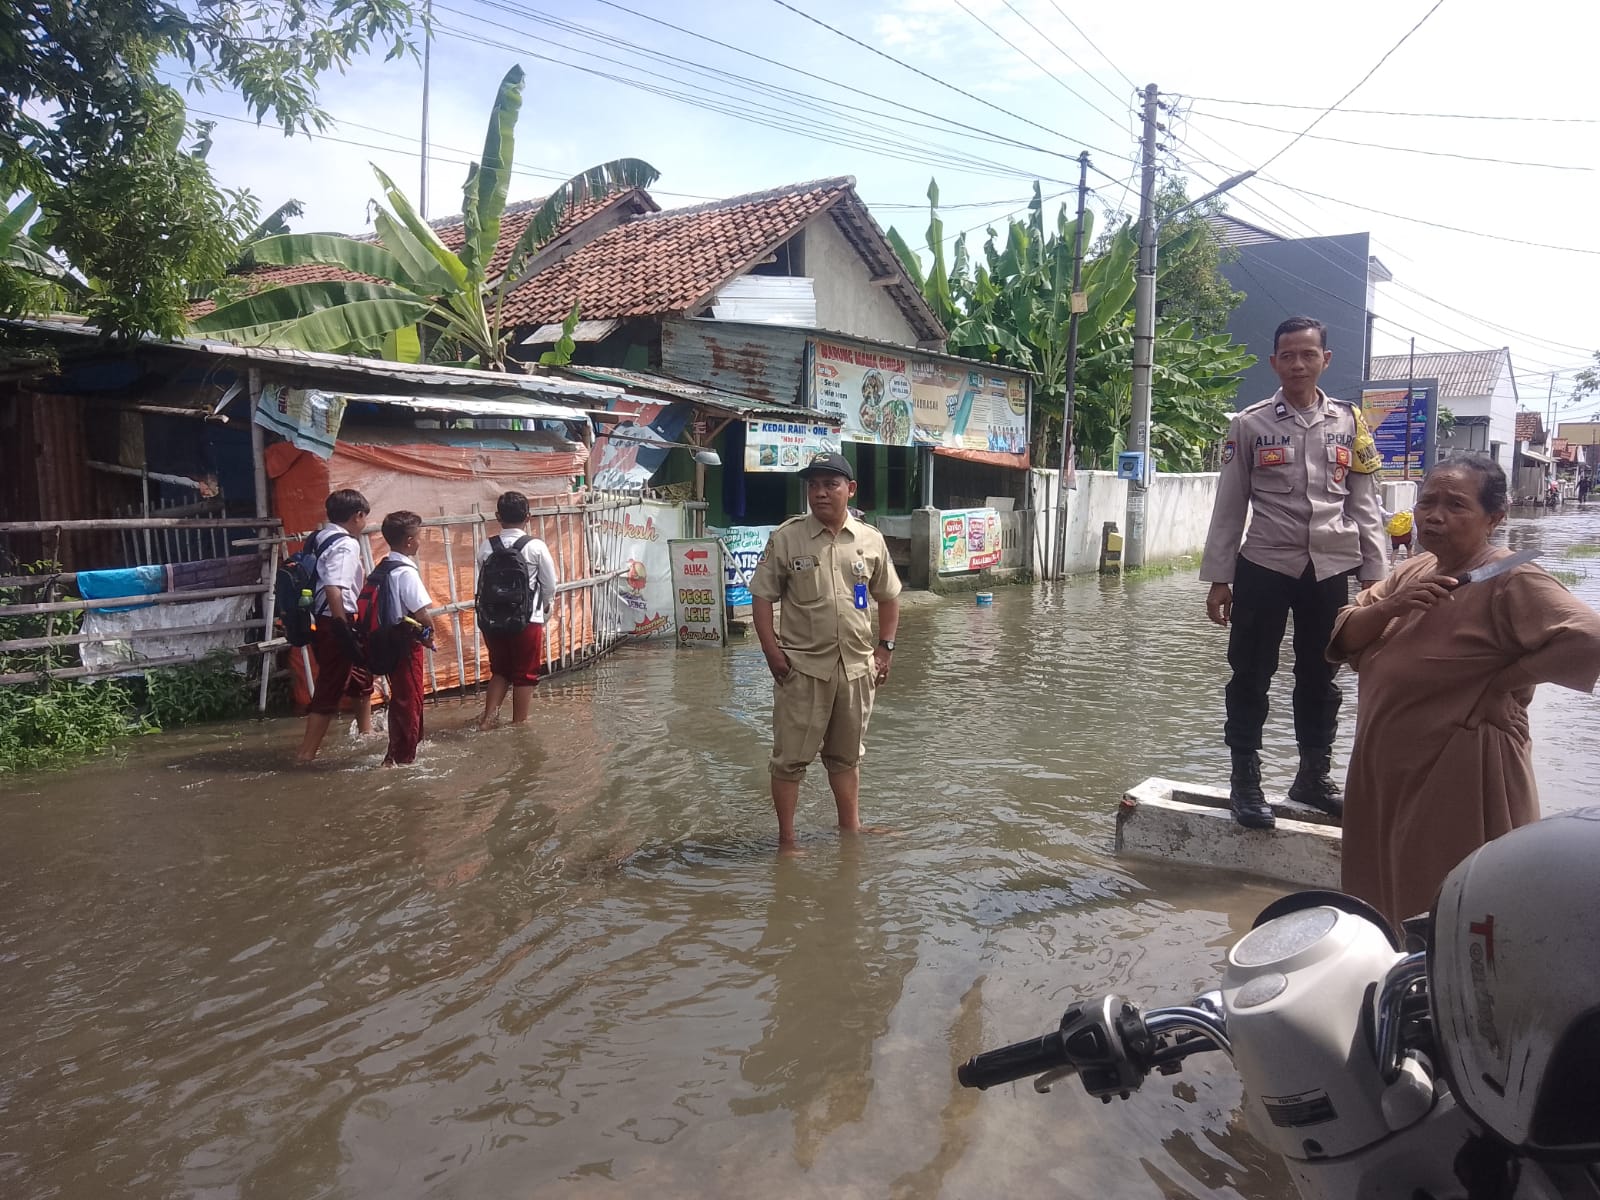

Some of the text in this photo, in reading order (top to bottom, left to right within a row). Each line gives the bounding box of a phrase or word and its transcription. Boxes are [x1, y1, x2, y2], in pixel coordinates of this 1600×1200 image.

[820, 343, 854, 364] WARUNG
[854, 351, 879, 369] MAMA
[761, 422, 786, 433] KEDAI
[812, 425, 828, 436] ONE
[683, 563, 709, 576] BUKA
[679, 588, 716, 605] PECEL
[684, 606, 711, 623] LELE
